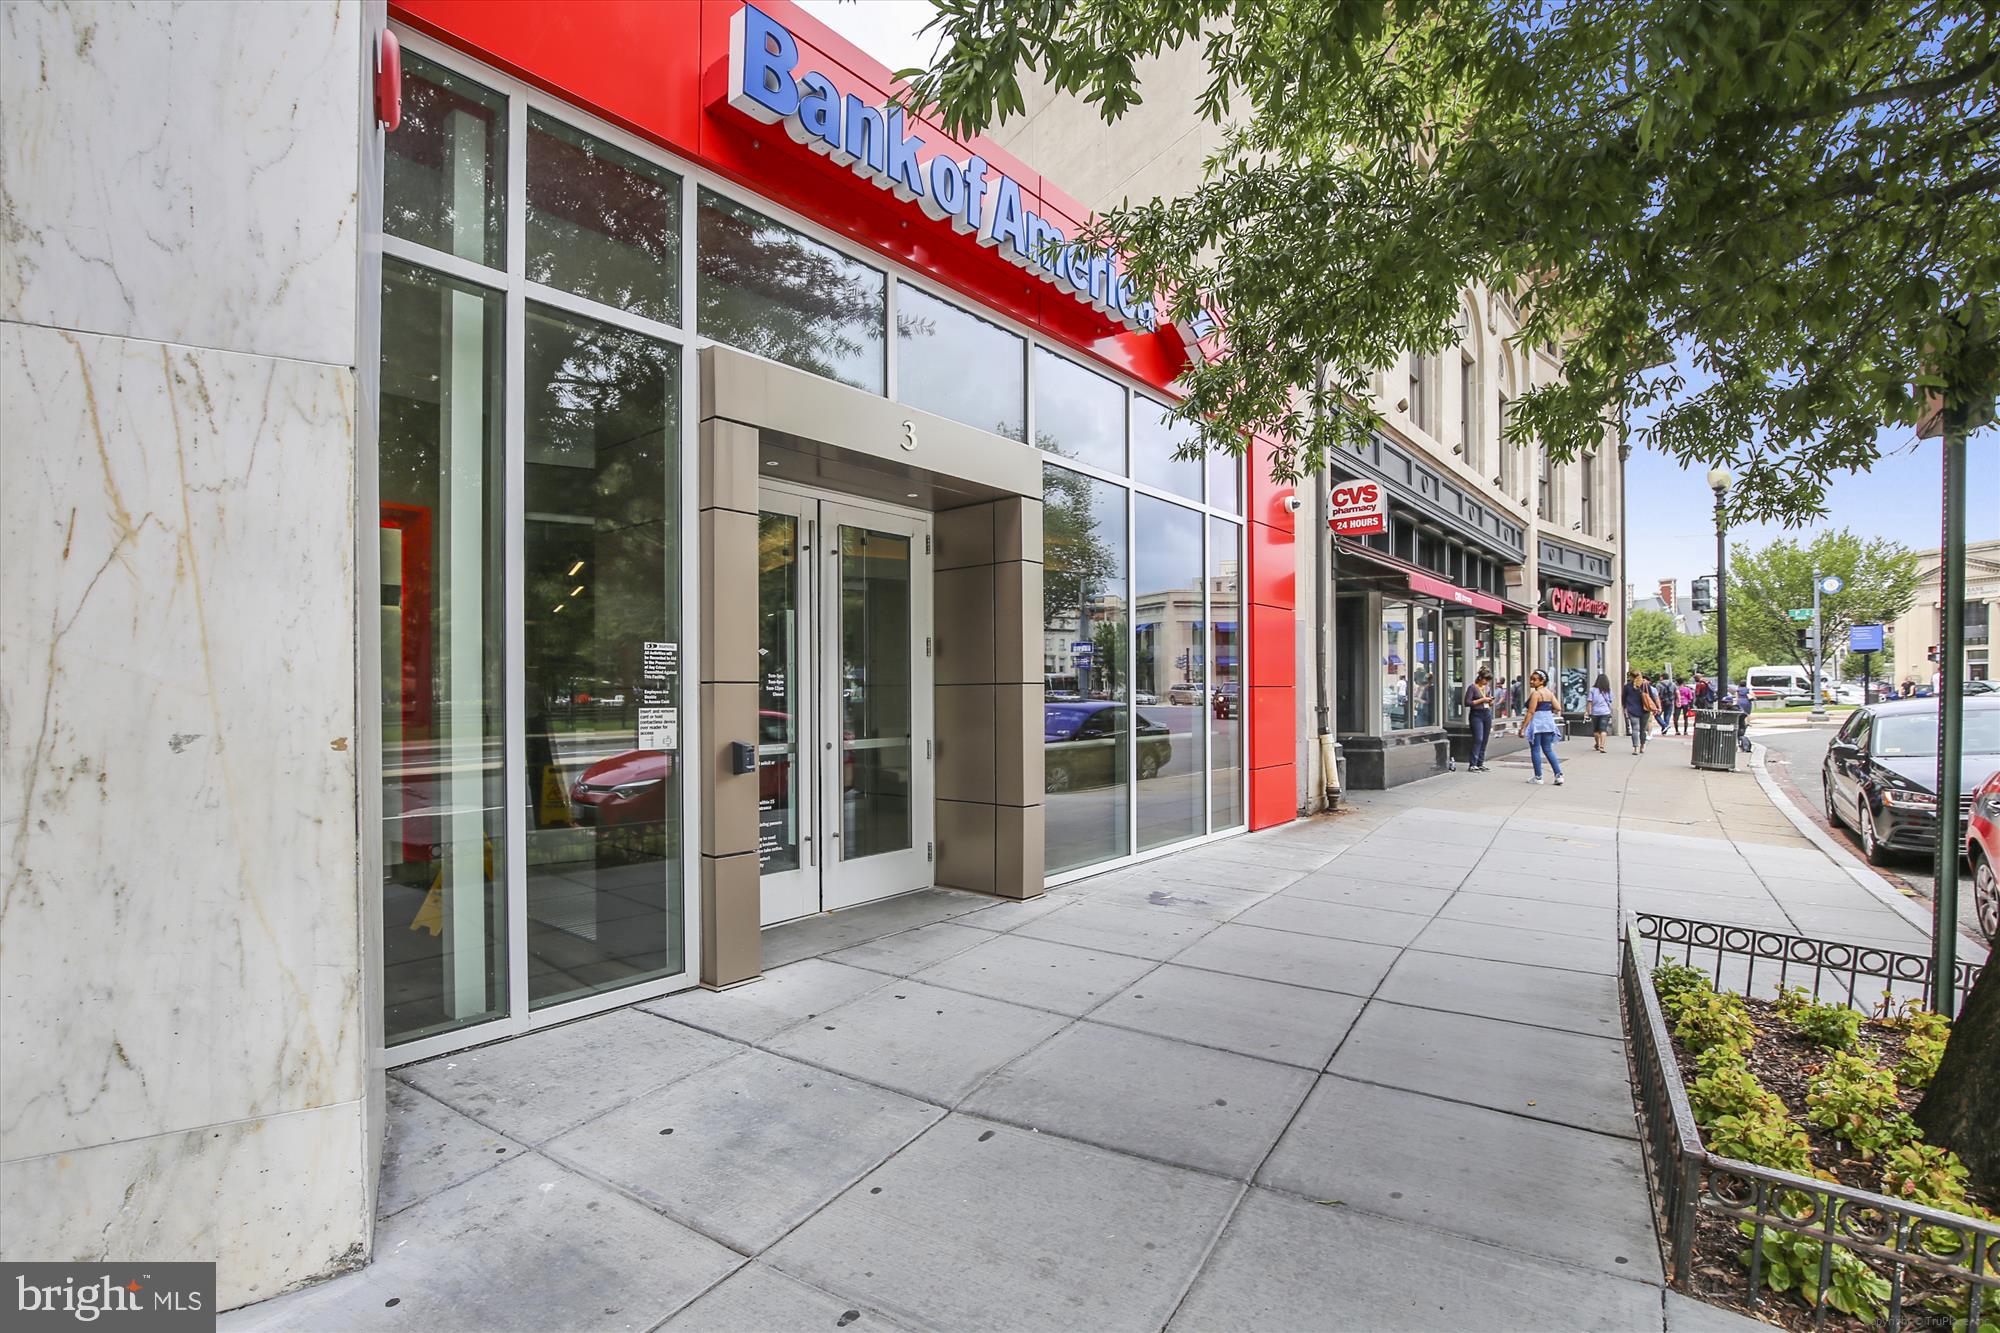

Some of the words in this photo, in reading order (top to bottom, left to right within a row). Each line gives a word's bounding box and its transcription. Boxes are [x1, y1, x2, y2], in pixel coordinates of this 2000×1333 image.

[742, 3, 927, 197] Bank
[930, 154, 988, 230] of
[991, 175, 1157, 334] America
[900, 419, 918, 451] 3
[1331, 484, 1378, 507] CVS
[1332, 504, 1376, 517] pharmacy
[1336, 521, 1348, 530] 24
[1350, 517, 1379, 528] HOURS
